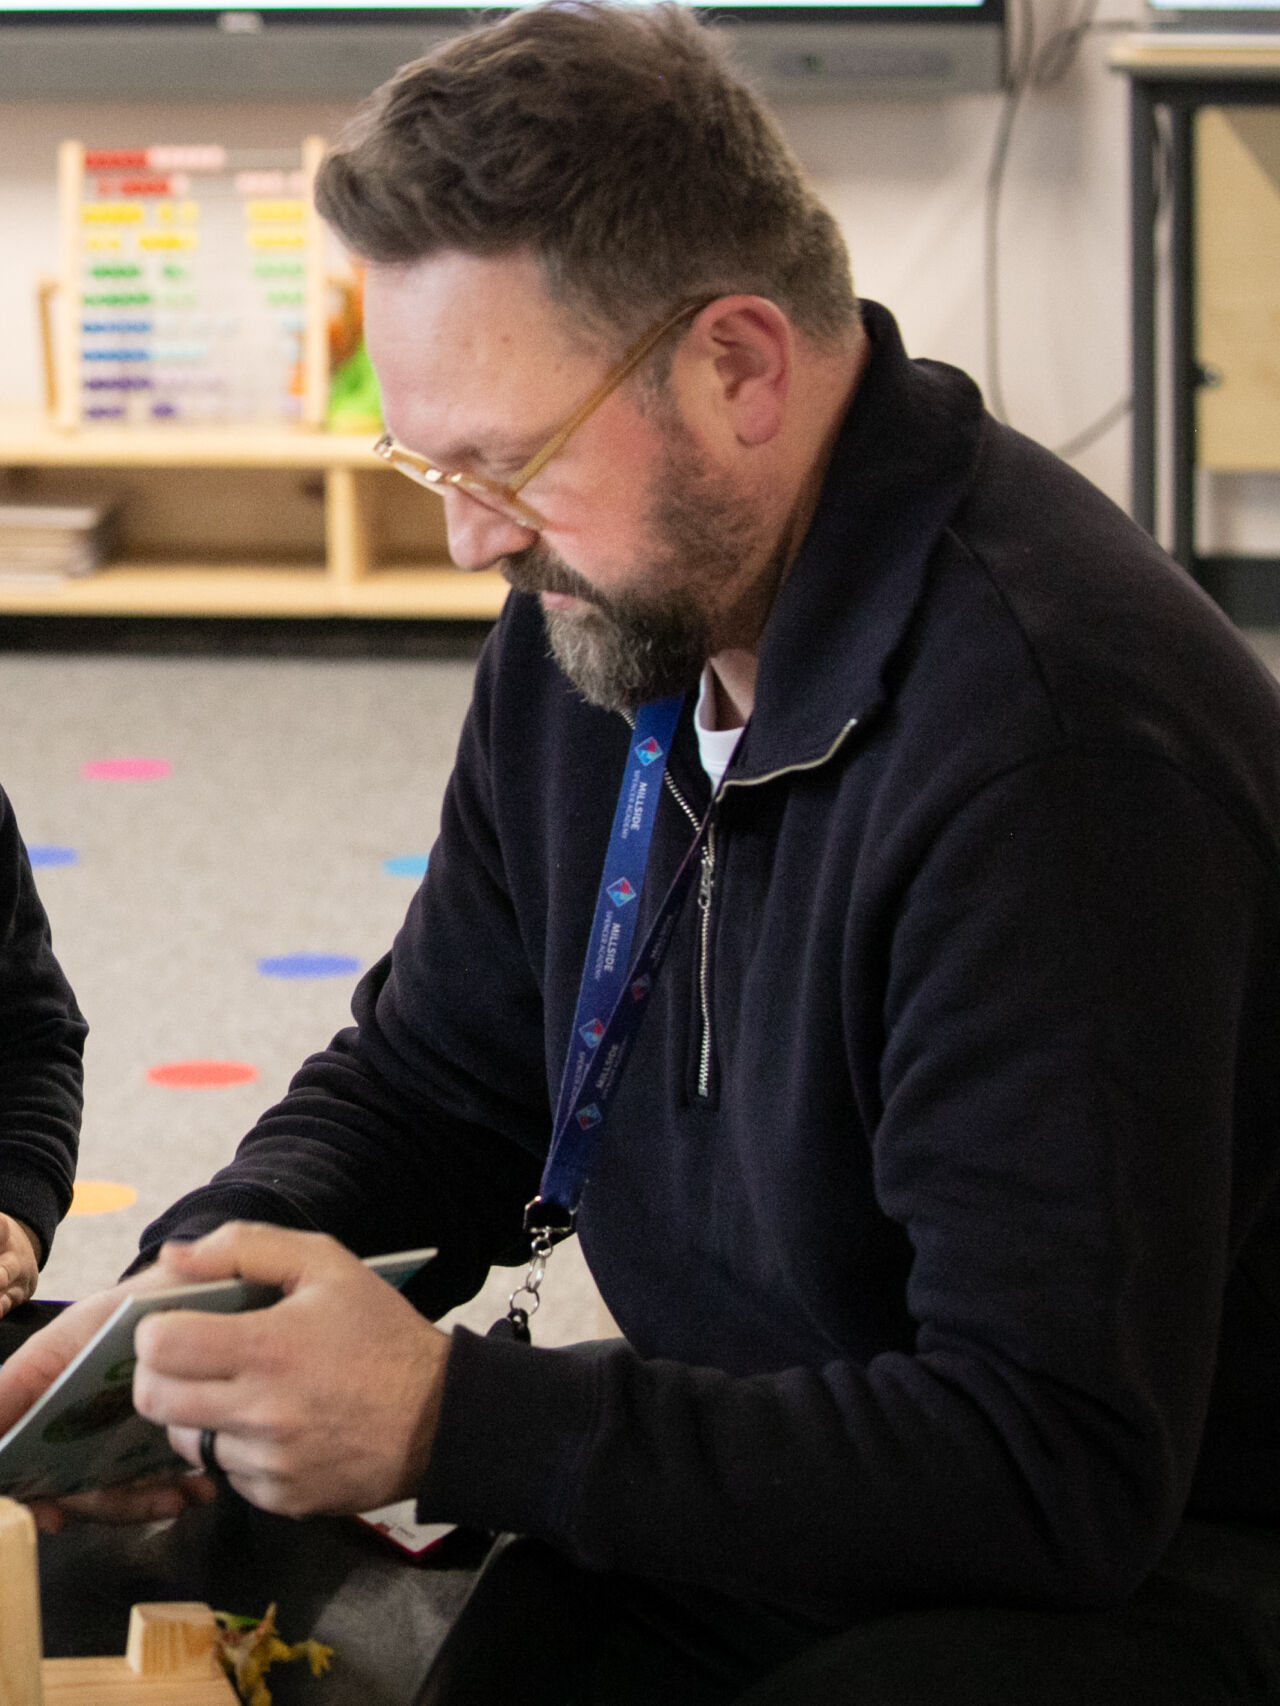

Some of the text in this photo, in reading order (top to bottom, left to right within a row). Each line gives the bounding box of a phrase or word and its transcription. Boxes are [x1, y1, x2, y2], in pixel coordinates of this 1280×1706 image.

[621, 770, 640, 839] SPENCER ACADEMY
[631, 781, 648, 831] MILLSIDE
[594, 911, 613, 980] SPENCER ACADEMY
[604, 922, 621, 972] MILLSIDE
